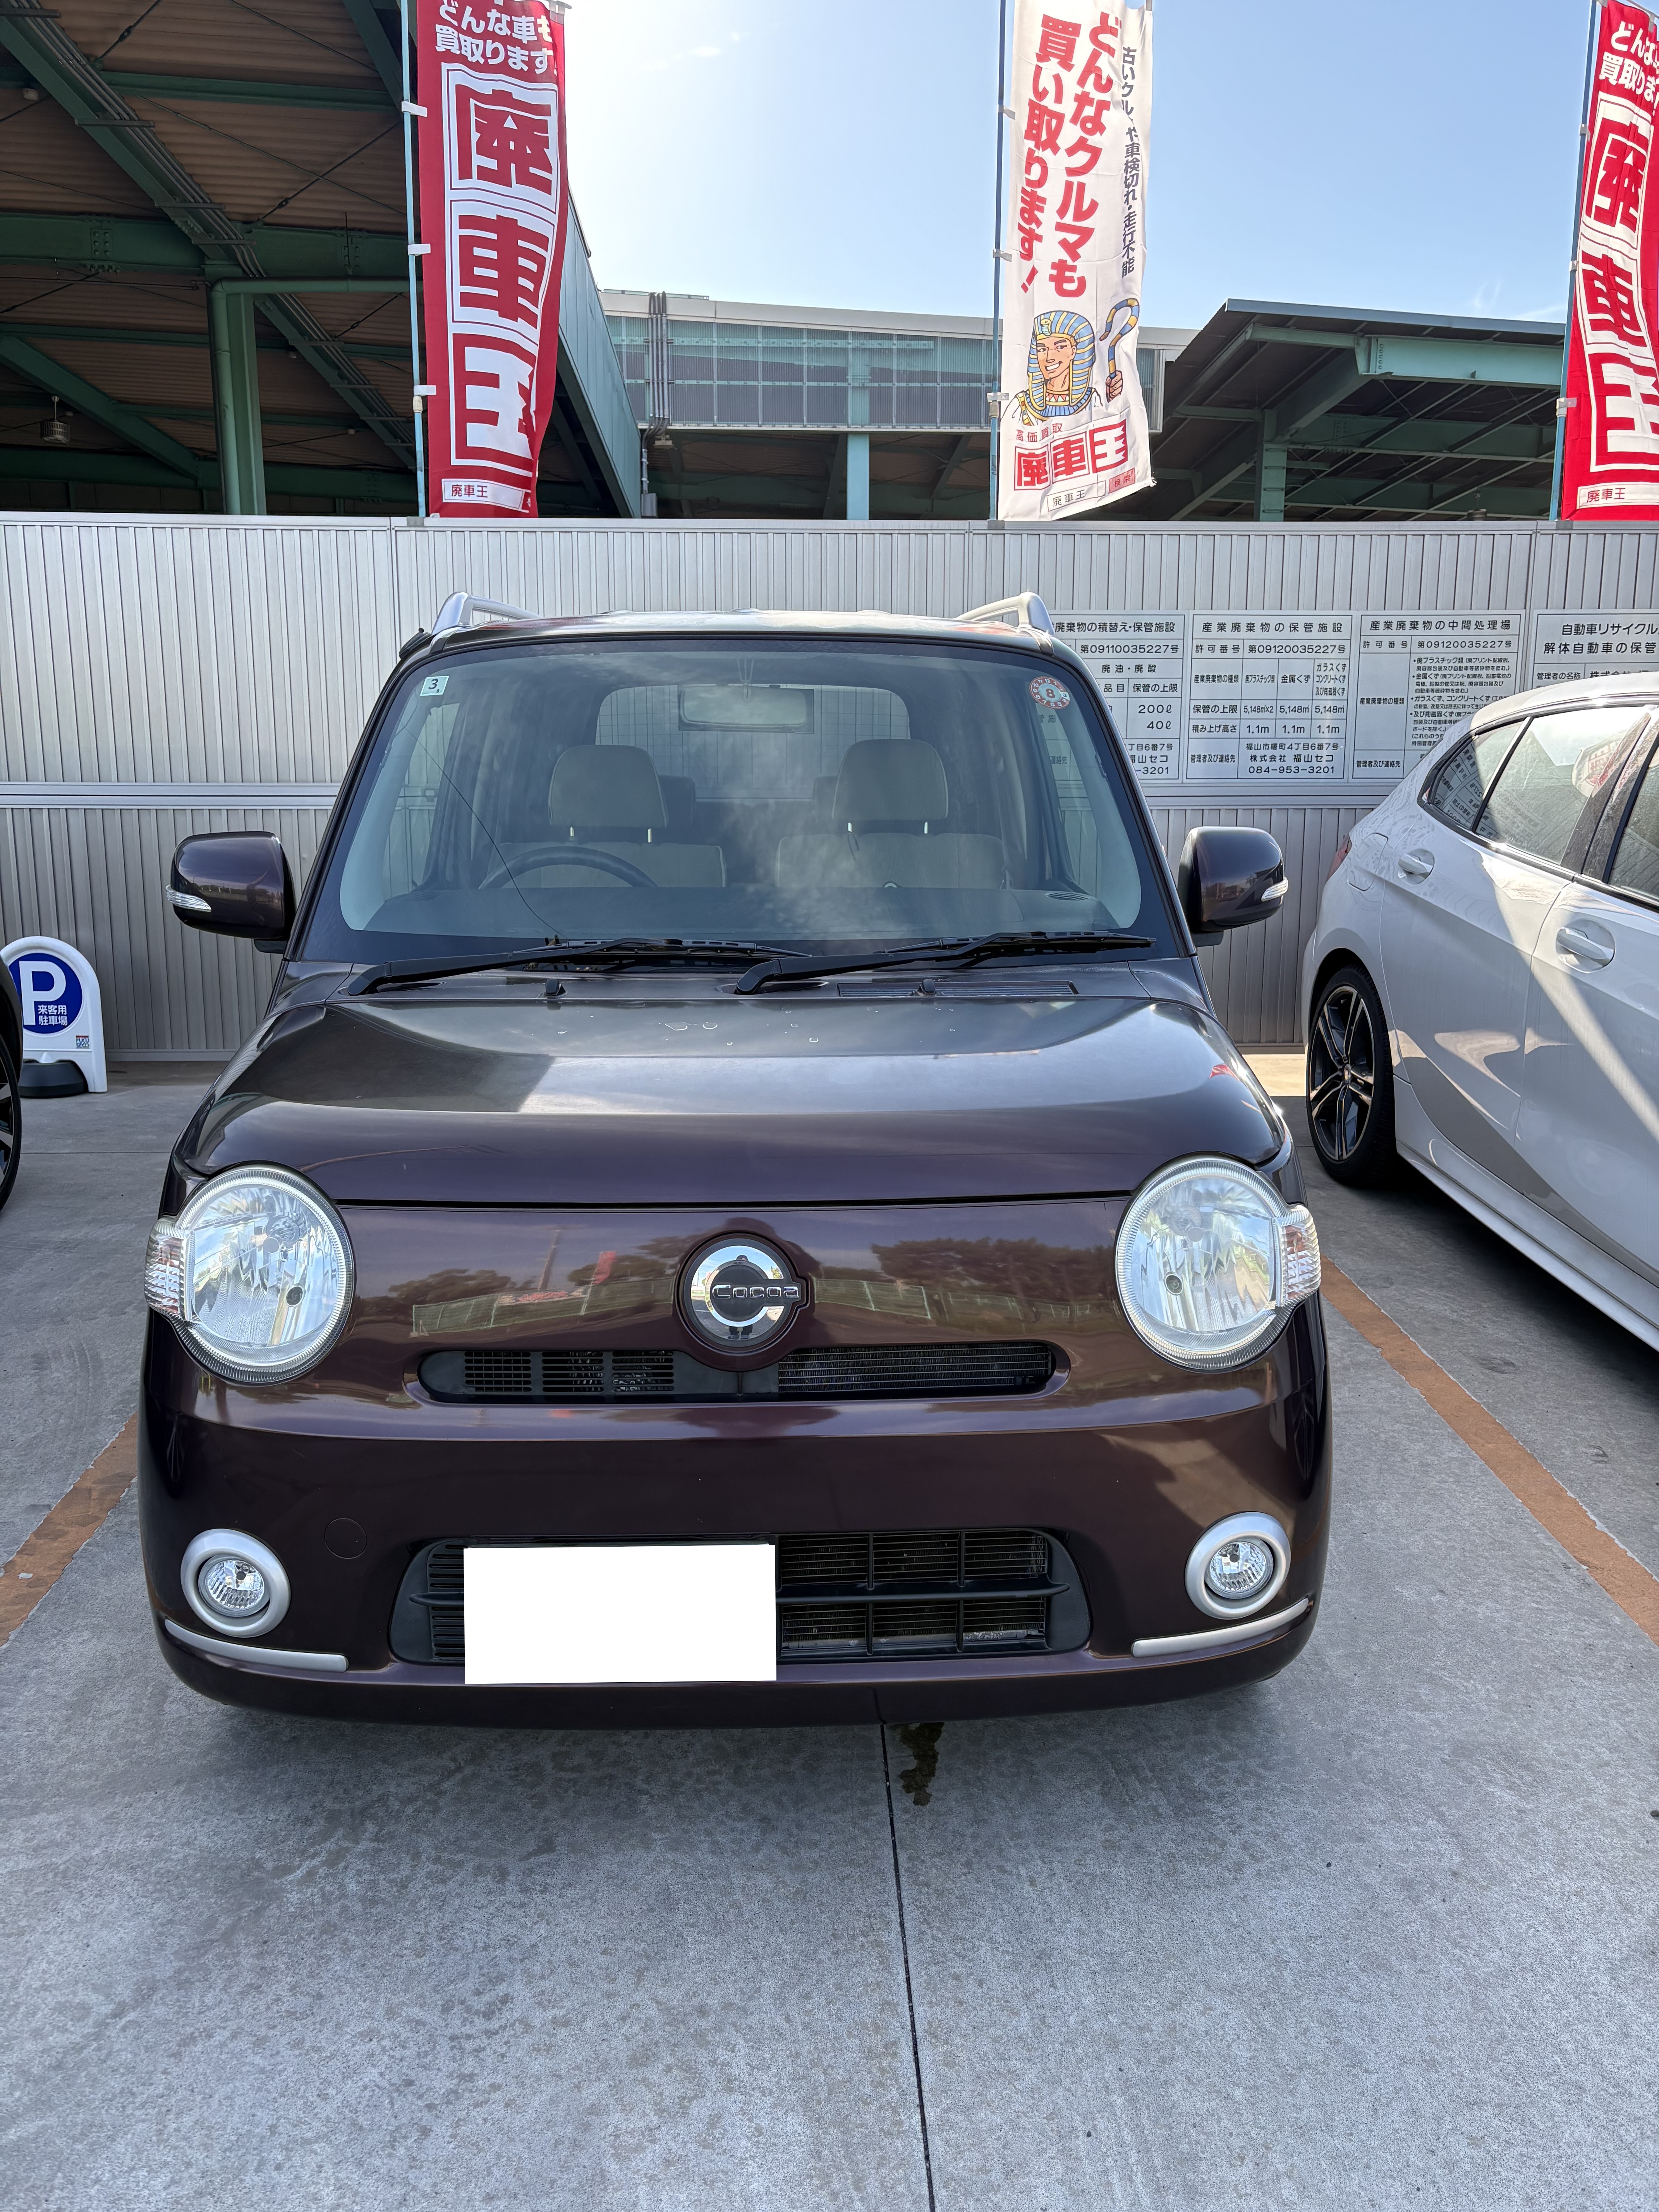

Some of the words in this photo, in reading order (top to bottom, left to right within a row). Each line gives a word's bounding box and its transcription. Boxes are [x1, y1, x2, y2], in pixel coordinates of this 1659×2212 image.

[440, 0, 553, 44] どんな車も
[435, 24, 557, 76] 買取ります
[1611, 21, 1659, 75] どんな
[1599, 51, 1659, 116] 買取りま!
[1017, 14, 1082, 294] 買い取ります!
[1048, 11, 1122, 298] どんなクルマも
[1121, 46, 1140, 278] 古いクルや車検切れ・走行不能
[454, 82, 554, 461] 廃車王
[1016, 423, 1063, 443] 高価買取
[1015, 418, 1128, 489] 廃車王
[451, 484, 488, 498] 廃車王
[1586, 487, 1626, 503] 廃車王
[1052, 622, 1175, 633] 廃棄物の積替え・保管施設
[1202, 622, 1343, 633] 産業廃棄物の保管施設
[1370, 620, 1511, 630] 産業廃棄物の中間処理場
[1562, 623, 1659, 635] 自動車リサイクル
[1080, 645, 1179, 654] 第09110035227号
[1195, 644, 1240, 654] 許可番号
[1248, 644, 1346, 654] 第09120035227号
[1417, 641, 1512, 649] 第09120035227号
[1544, 642, 1657, 654] 解体自動車の保管
[1317, 663, 1347, 672] ガラスくず
[428, 678, 438, 690] 3
[1194, 674, 1239, 683] 産業廃棄物の種類
[1281, 675, 1311, 684] 金属くず
[1316, 675, 1346, 684] コンクリートくず
[1046, 688, 1055, 699] 8
[1099, 684, 1125, 692] 品目
[1133, 684, 1178, 692] 保管の上限
[1192, 704, 1238, 714] 保管の上限
[1192, 724, 1237, 733] 積み上げ高さ
[1247, 725, 1269, 733] 1.1m
[1282, 725, 1305, 733] 1.1m
[1317, 725, 1340, 733] 1.1m
[1125, 743, 1173, 751] 丁目6番7号
[1190, 754, 1236, 763] 管理者及び連絡先
[1250, 754, 1286, 763] 株式会社
[1293, 754, 1334, 763] 福山セコ
[1248, 766, 1334, 774] 084-953-3201
[19, 960, 66, 1025] P
[38, 1004, 67, 1015] 来客用
[38, 1015, 68, 1026] 駐車場
[712, 1285, 799, 1299] Cocoa
